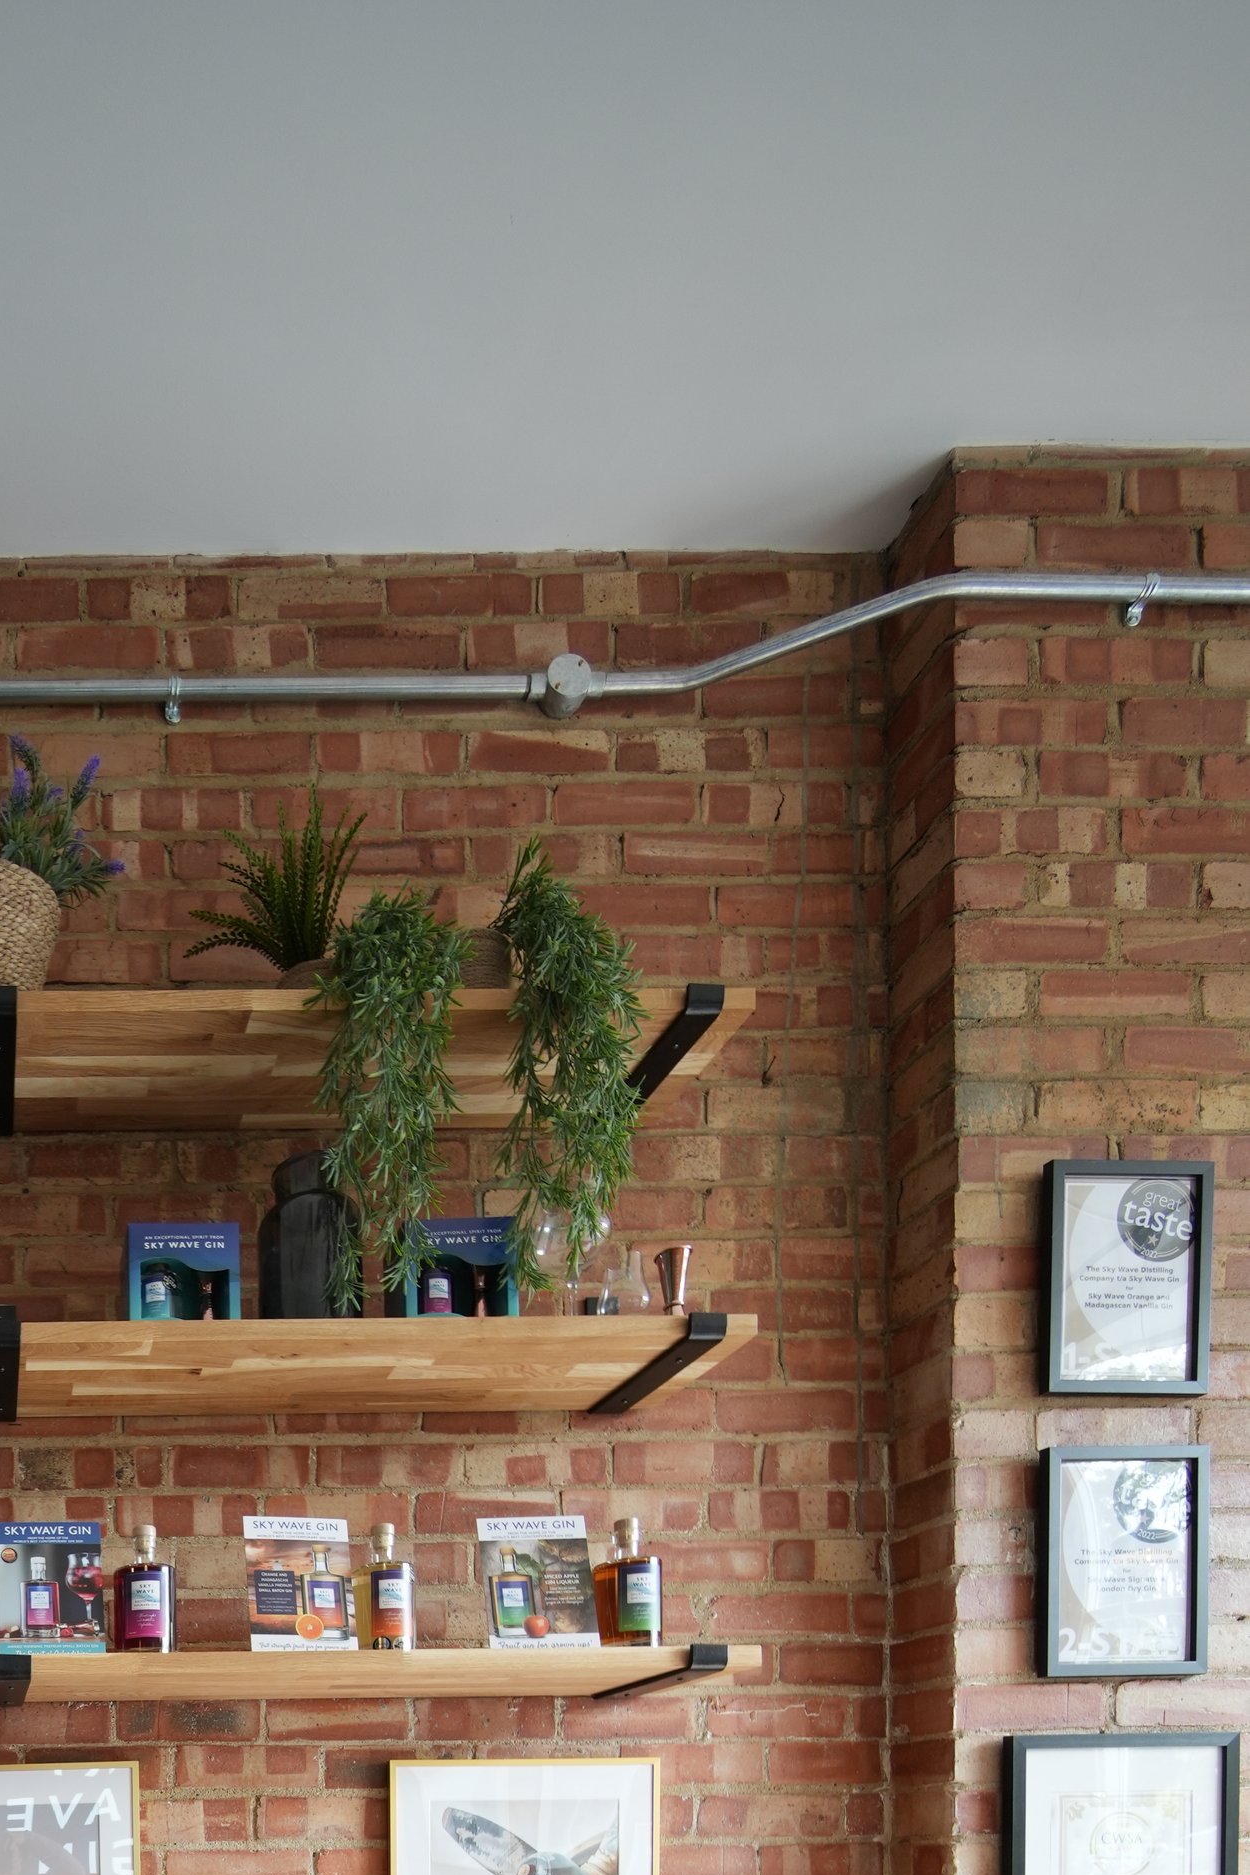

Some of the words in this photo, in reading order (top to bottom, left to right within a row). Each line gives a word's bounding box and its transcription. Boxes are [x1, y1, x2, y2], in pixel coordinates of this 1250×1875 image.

[1143, 1191, 1182, 1212] great
[1124, 1200, 1193, 1241] taste
[168, 1241, 200, 1249] WAVE
[204, 1241, 225, 1249] GIN
[445, 1236, 476, 1244] WAVE
[1141, 1249, 1158, 1258] 2022
[1102, 1266, 1115, 1274] Sky
[1141, 1266, 1174, 1274] Distilling
[1080, 1275, 1114, 1283] Company
[1127, 1293, 1154, 1301] Orange
[253, 1521, 276, 1530] SKY
[278, 1522, 311, 1531] WAVE
[316, 1522, 338, 1532] GIN
[487, 1522, 509, 1531] SKY
[512, 1521, 548, 1530] WAVE
[552, 1520, 575, 1529] GIN
[4, 1526, 27, 1536] SKY
[30, 1526, 64, 1535] WAVE
[69, 1526, 91, 1535] GIN
[1137, 1529, 1156, 1539] 2022
[1101, 1832, 1142, 1844] CWSA
